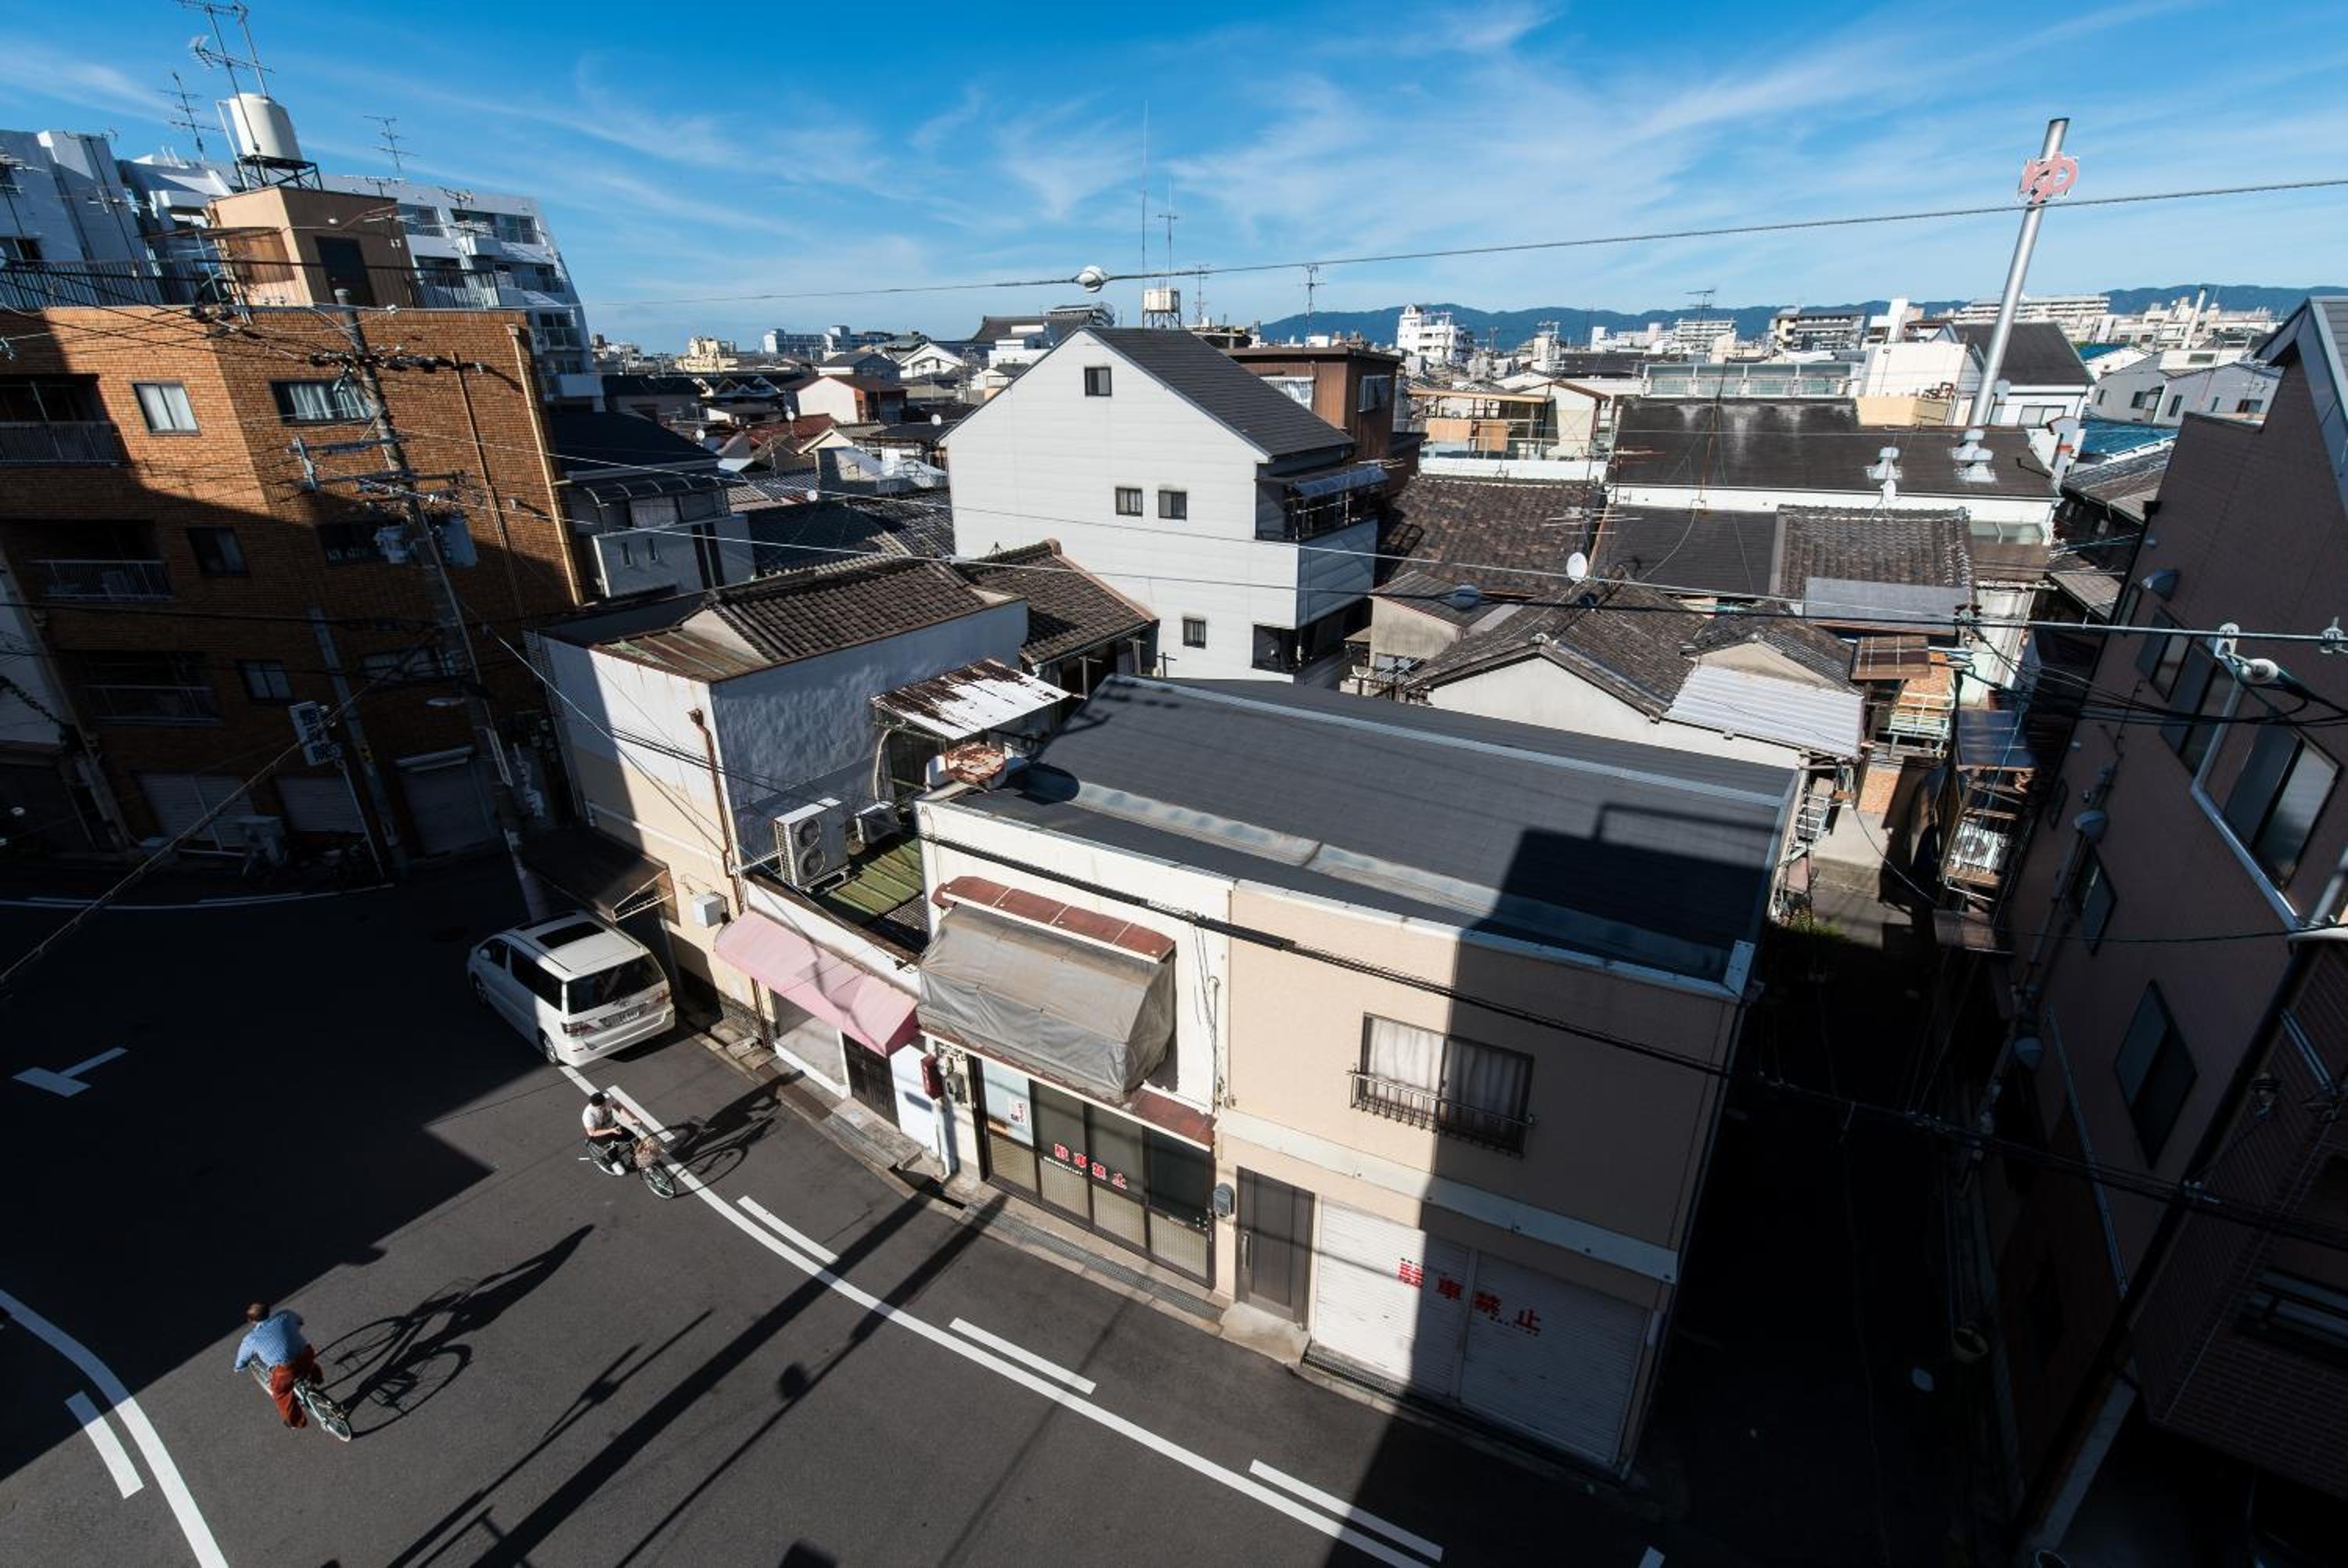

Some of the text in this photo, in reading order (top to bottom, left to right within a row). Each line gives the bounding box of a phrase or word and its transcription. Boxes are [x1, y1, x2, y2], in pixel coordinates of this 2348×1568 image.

[2021, 151, 2078, 204] ゆ
[1399, 1262, 1541, 1332] 駐車禁止
